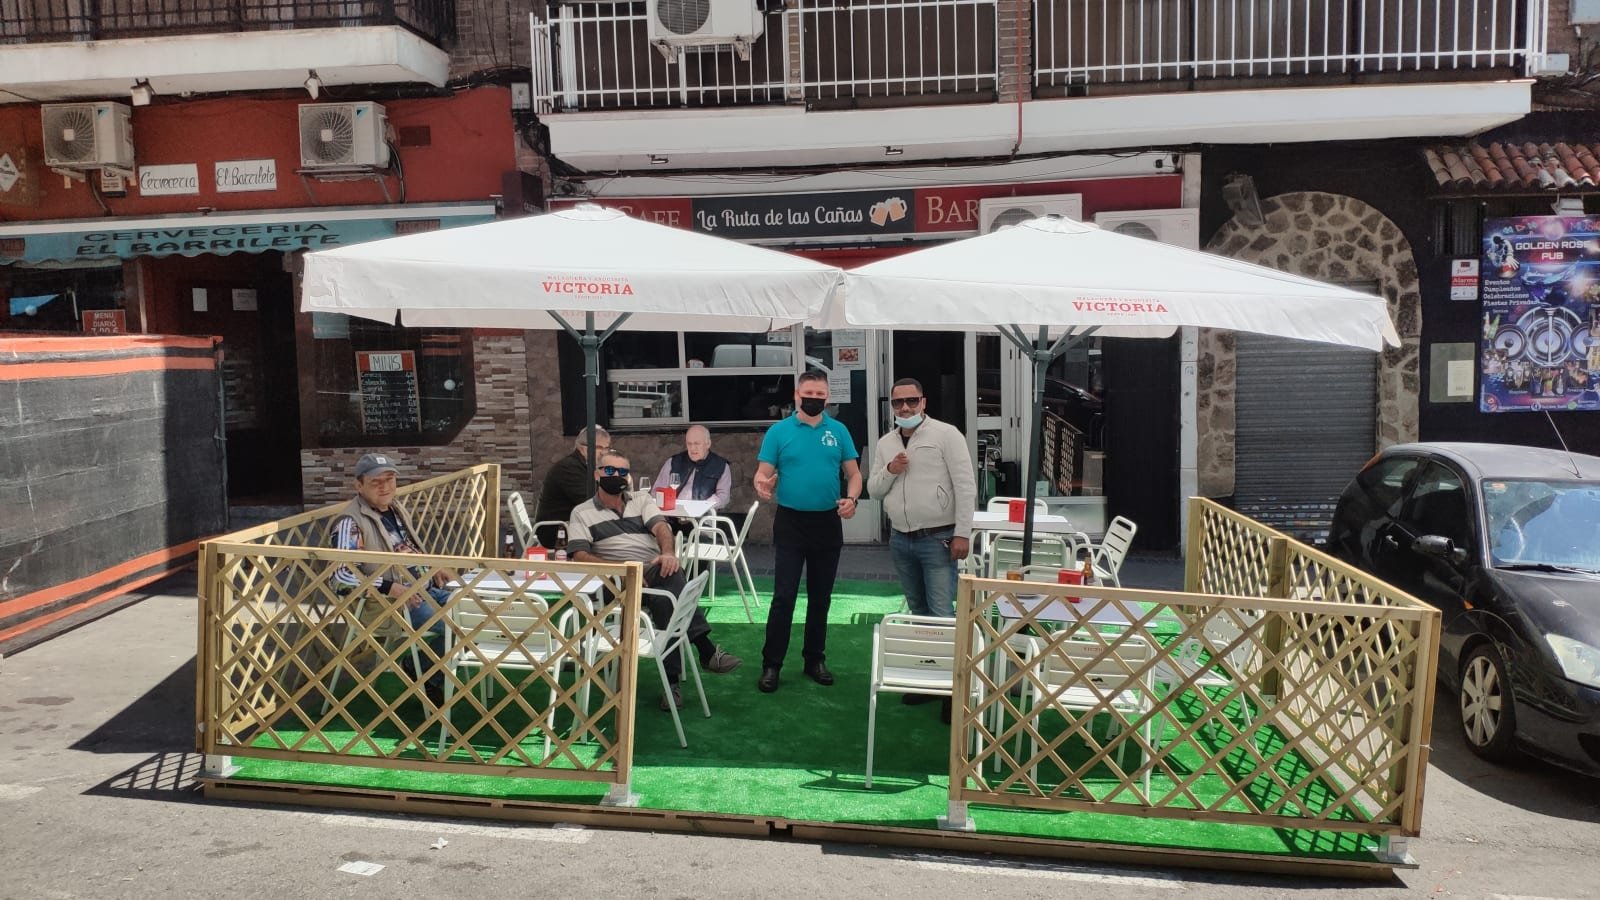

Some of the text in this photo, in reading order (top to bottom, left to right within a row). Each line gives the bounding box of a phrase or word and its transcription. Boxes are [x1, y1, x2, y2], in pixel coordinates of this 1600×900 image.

[216, 164, 275, 186] El Barrilete
[697, 205, 863, 231] La Ruta de las Cañas
[924, 196, 980, 225] BAR
[83, 223, 329, 242] CERVECERIA
[75, 234, 342, 256] EL BARRILETE
[1515, 240, 1591, 251] GOLDEN ROSE
[1541, 252, 1564, 260] PUB
[542, 281, 634, 295] VICTORIA
[1072, 301, 1168, 312] VICTORIA
[372, 355, 401, 371] MINIS
